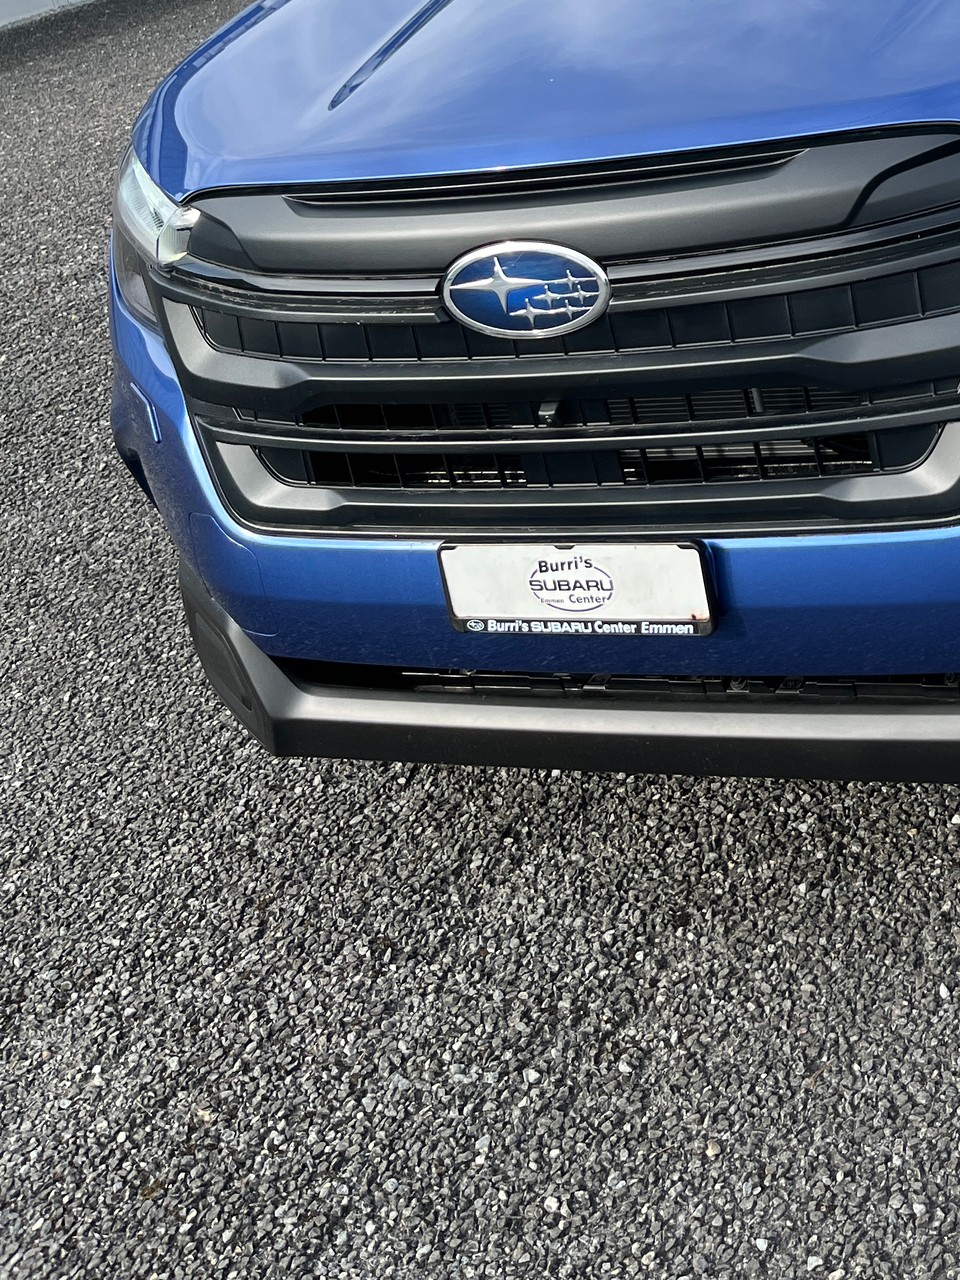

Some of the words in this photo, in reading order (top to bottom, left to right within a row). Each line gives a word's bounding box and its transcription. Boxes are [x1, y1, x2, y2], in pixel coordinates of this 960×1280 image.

[538, 555, 593, 573] Burri's
[529, 580, 614, 591] SUBARU
[568, 593, 606, 604] Center
[487, 619, 529, 632] Burri's
[531, 621, 592, 633] SUBARU
[594, 620, 636, 633] Center
[641, 621, 694, 634] Emmen
